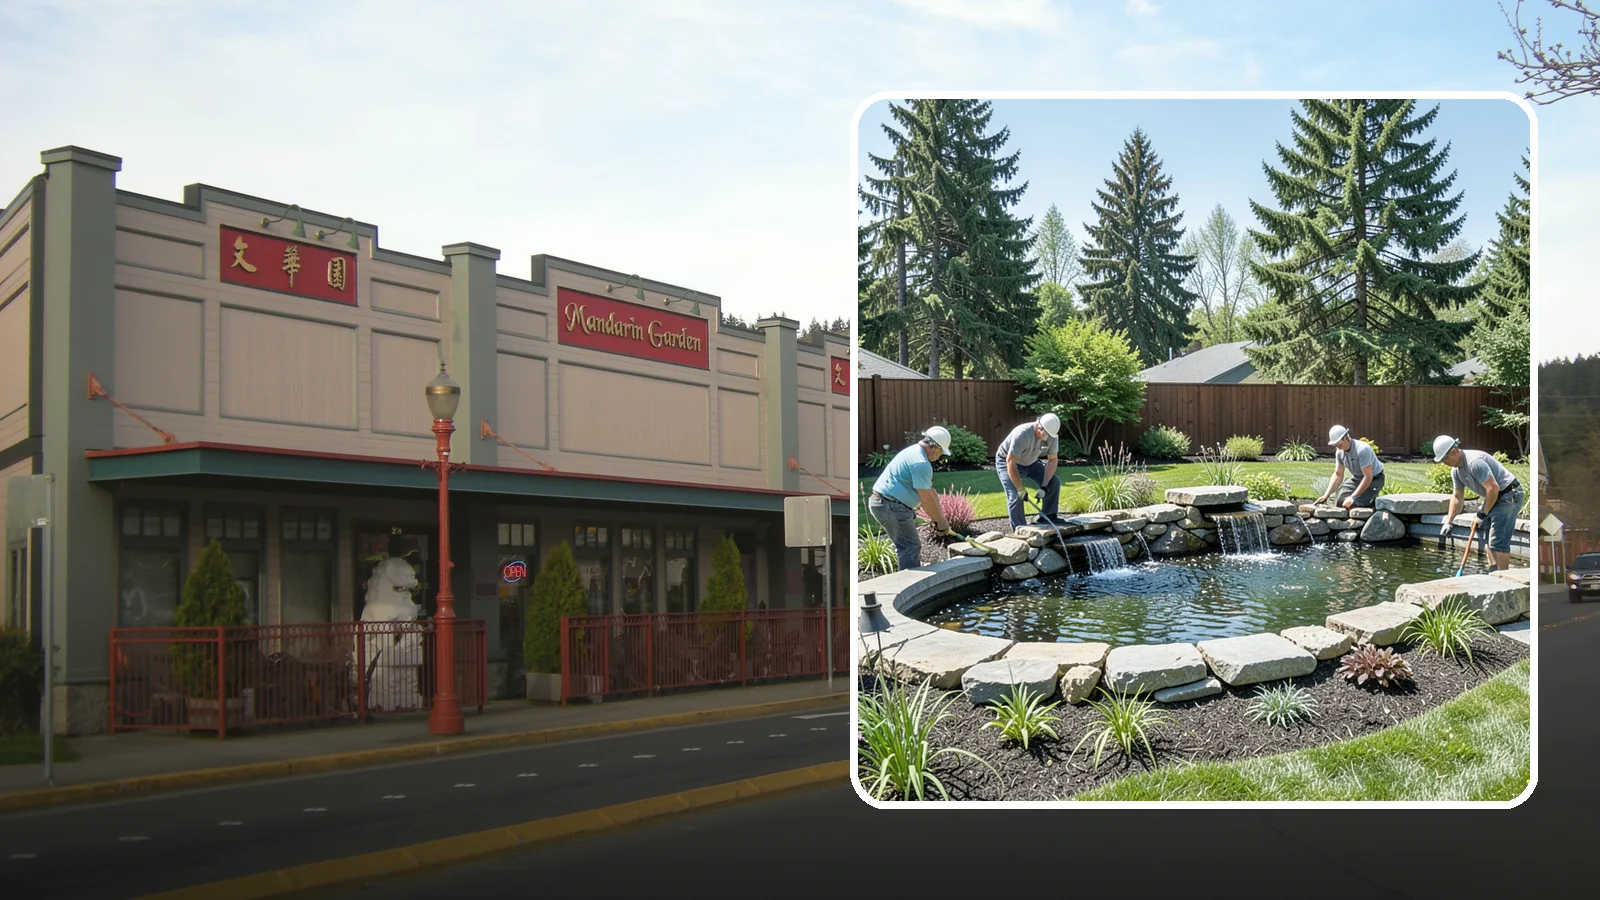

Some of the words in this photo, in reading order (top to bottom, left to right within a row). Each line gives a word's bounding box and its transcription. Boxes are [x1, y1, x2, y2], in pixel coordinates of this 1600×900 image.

[230, 235, 347, 291] 文華園
[564, 302, 644, 341] Mandarin
[647, 320, 702, 352] Garden
[503, 564, 527, 578] OPEN
